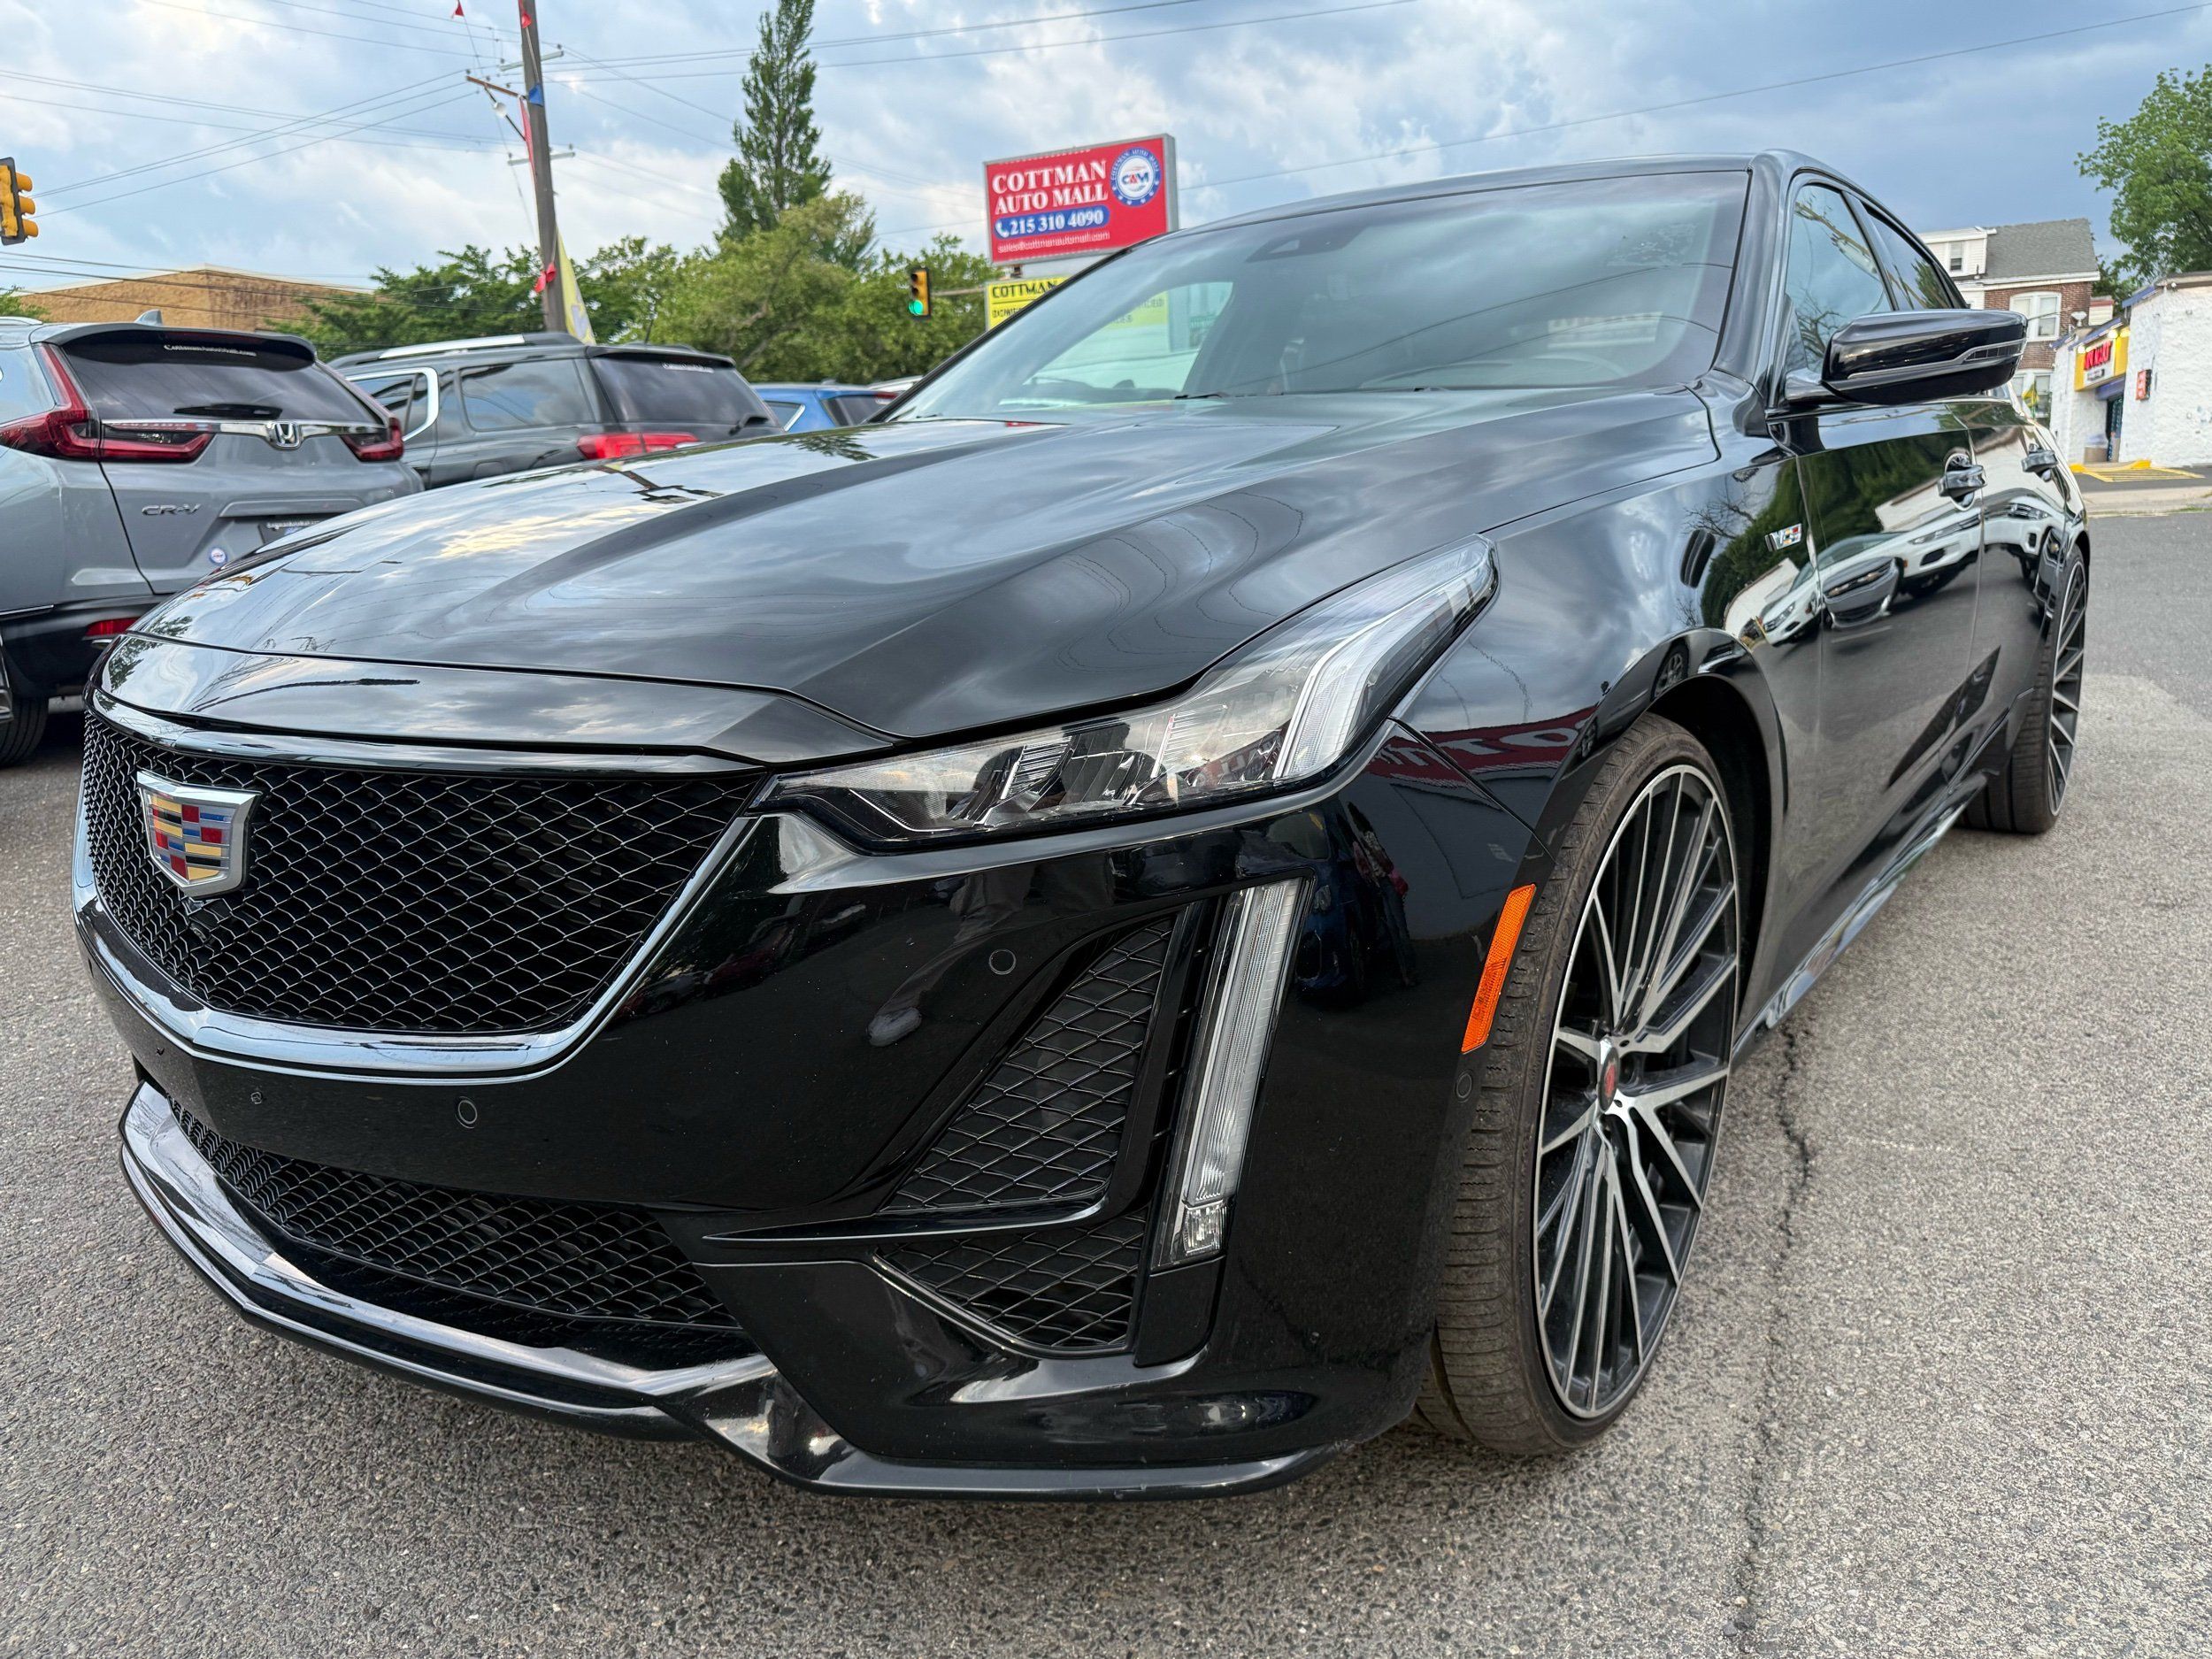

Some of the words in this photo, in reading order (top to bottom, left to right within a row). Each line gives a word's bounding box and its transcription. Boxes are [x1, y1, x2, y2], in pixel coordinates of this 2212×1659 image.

[992, 160, 1107, 194] COTTMAN
[995, 190, 1048, 214] AUTO
[1052, 183, 1108, 207] MALL
[1010, 217, 1035, 235] 215
[1038, 213, 1065, 231] 310
[1067, 209, 1104, 227] 4090
[142, 503, 201, 515] CR-V
